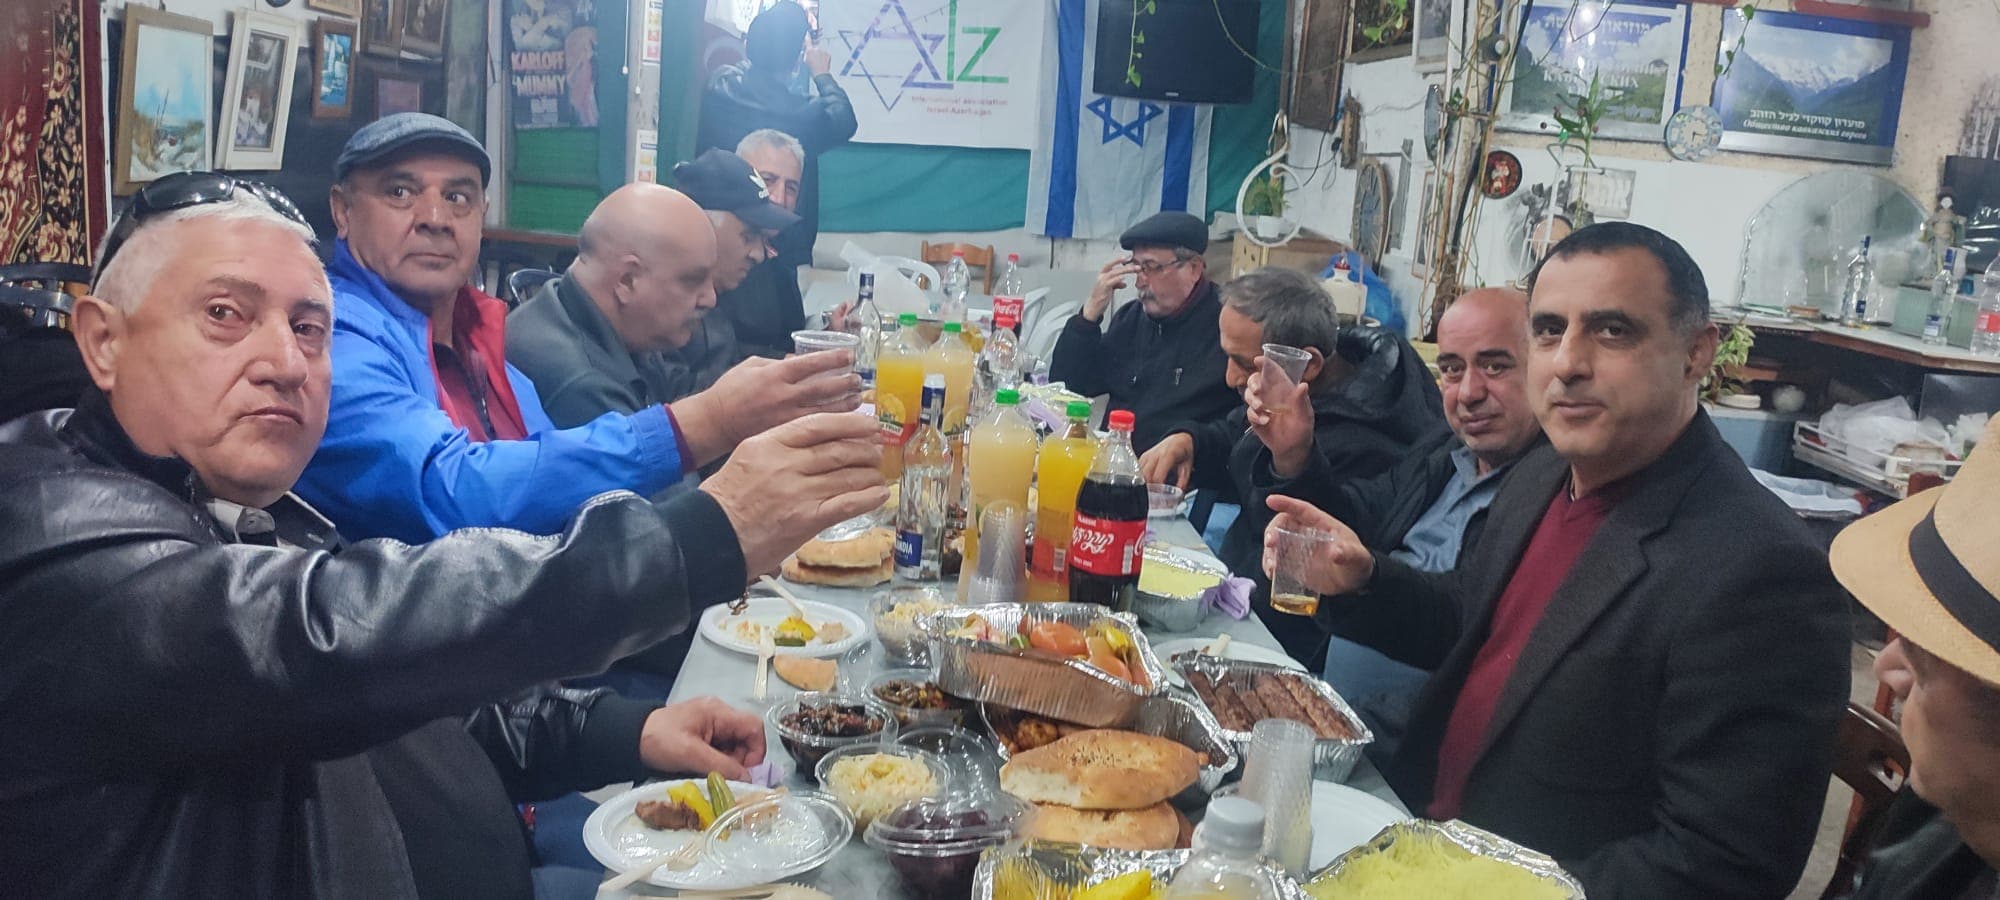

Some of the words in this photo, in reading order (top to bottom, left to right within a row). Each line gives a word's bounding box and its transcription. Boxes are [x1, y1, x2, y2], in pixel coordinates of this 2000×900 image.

[511, 51, 566, 71] KARLOFF
[517, 74, 566, 96] MUMMY
[1750, 108, 1776, 119] הזהב
[1779, 109, 1800, 121] לגיל
[1802, 113, 1832, 126] קווקזי
[1834, 117, 1865, 128] מועדון
